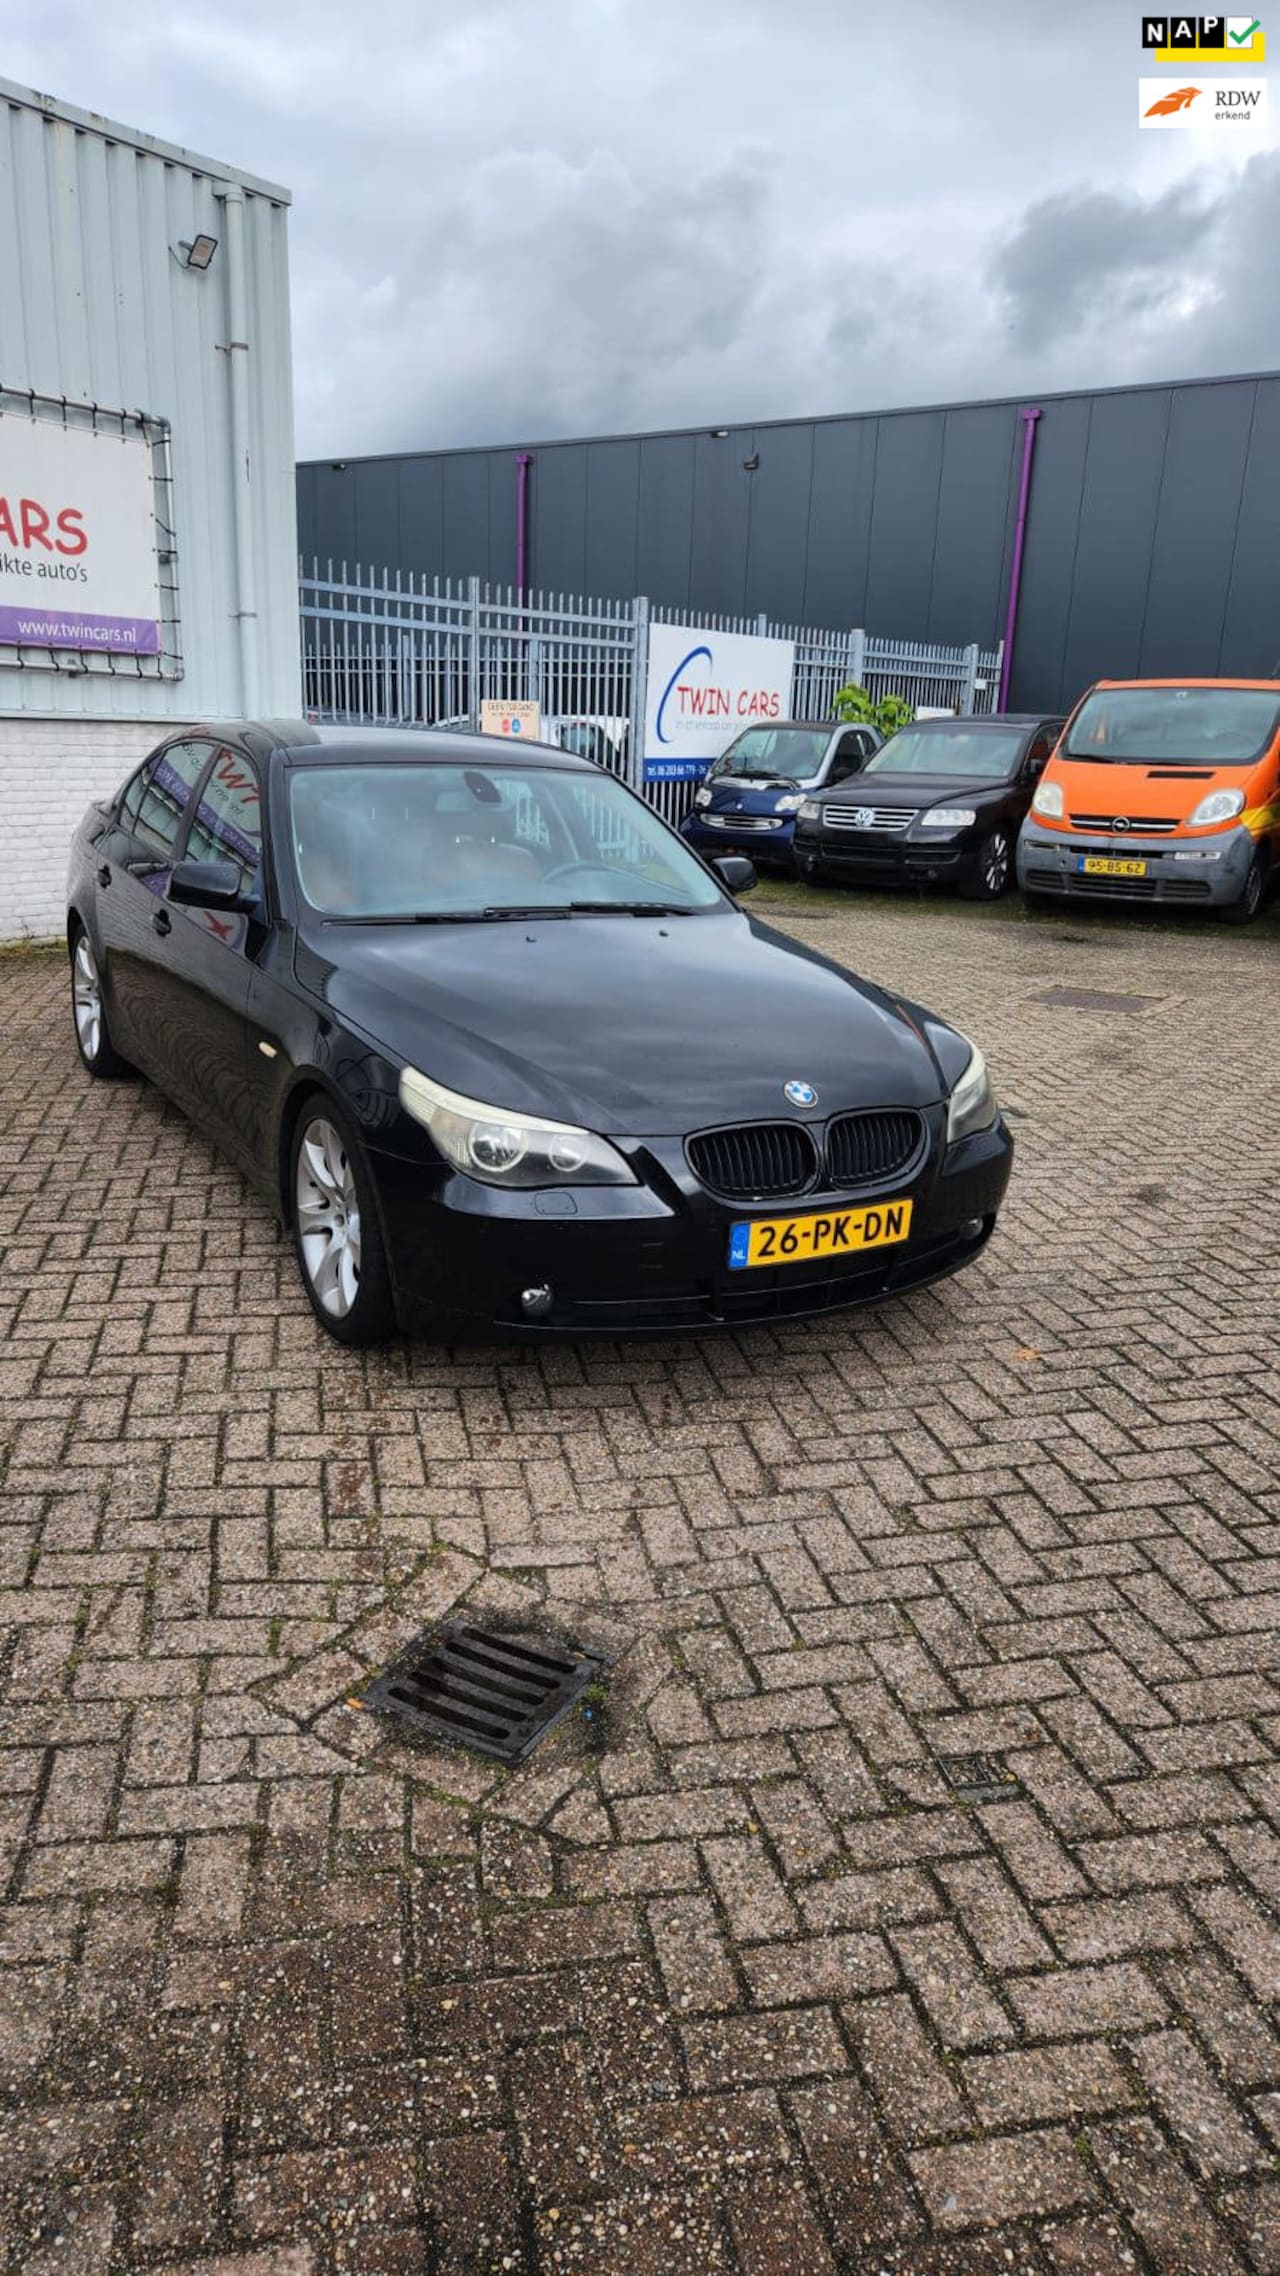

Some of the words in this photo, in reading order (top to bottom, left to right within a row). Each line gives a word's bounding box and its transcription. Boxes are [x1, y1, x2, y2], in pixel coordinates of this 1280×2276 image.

[37, 562, 88, 583] auto's
[18, 620, 136, 643] www.twincars.nl
[677, 686, 730, 715] TWIN
[737, 690, 779, 717] CARS
[757, 1206, 904, 1258] 26-PK-DN
[732, 1249, 746, 1259] NL
